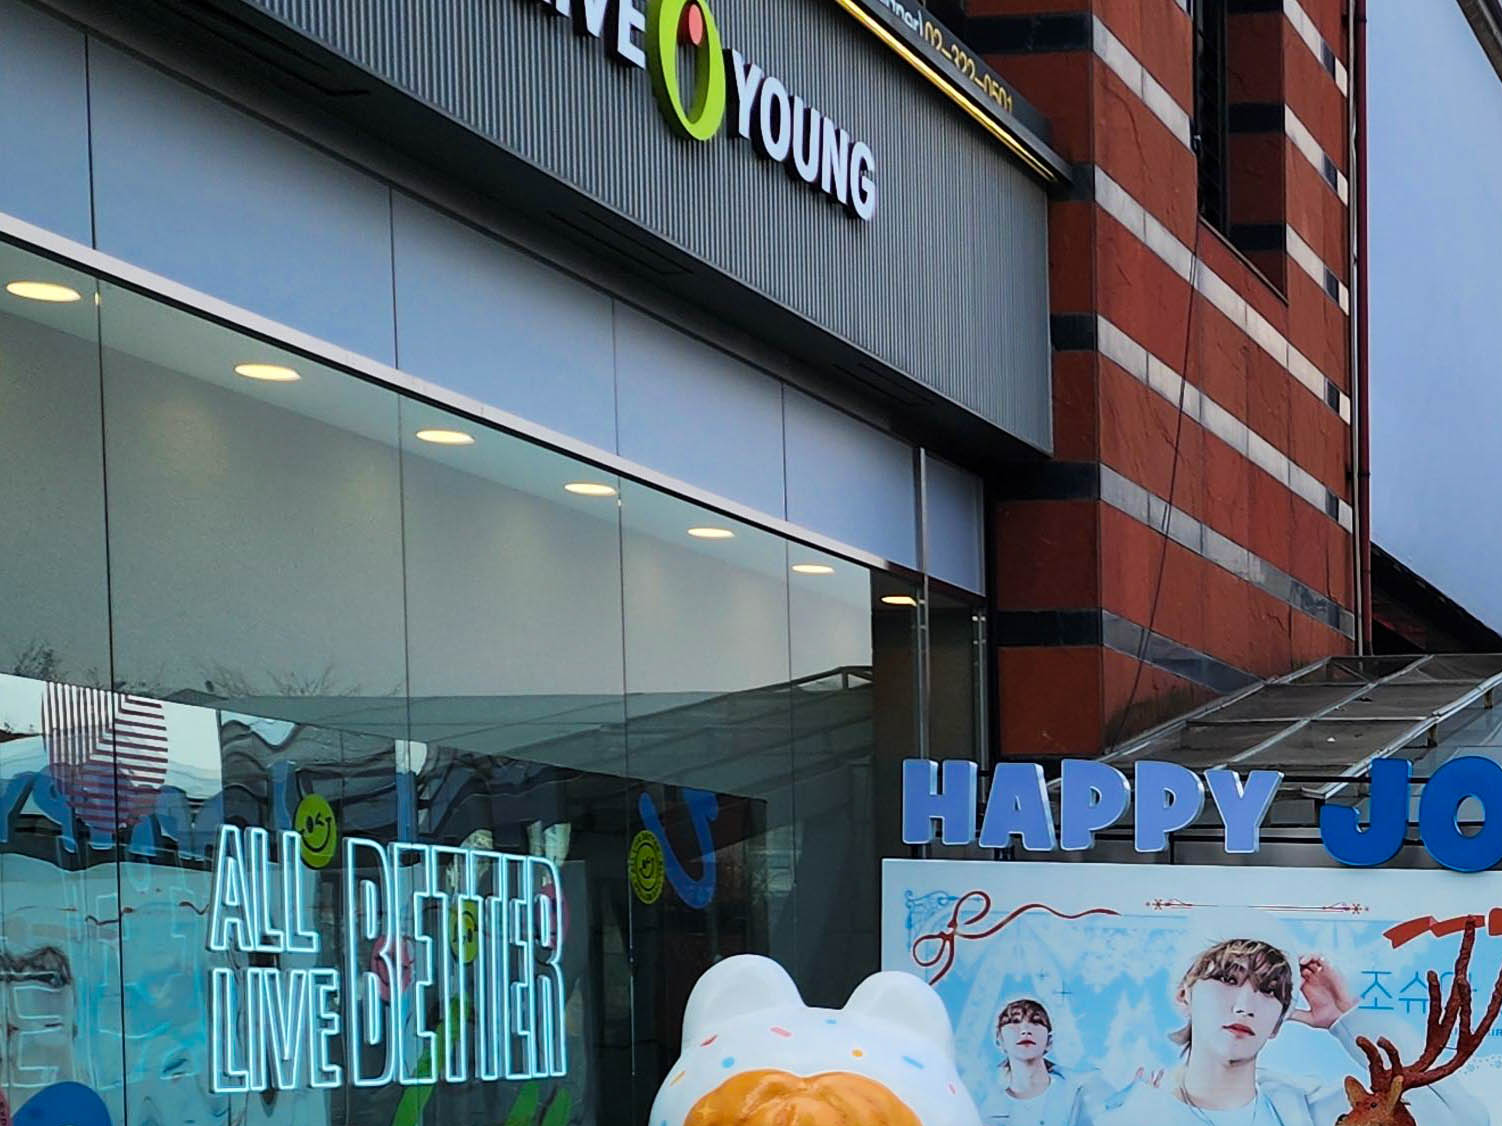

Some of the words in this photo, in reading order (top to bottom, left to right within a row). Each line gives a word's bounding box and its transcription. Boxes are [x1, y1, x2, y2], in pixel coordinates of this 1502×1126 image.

[730, 48, 876, 221] YOUNG
[902, 758, 1285, 854] HAPPY
[209, 824, 319, 953] ALL
[344, 836, 568, 1087] BETTER
[211, 967, 342, 1093] LIVE
